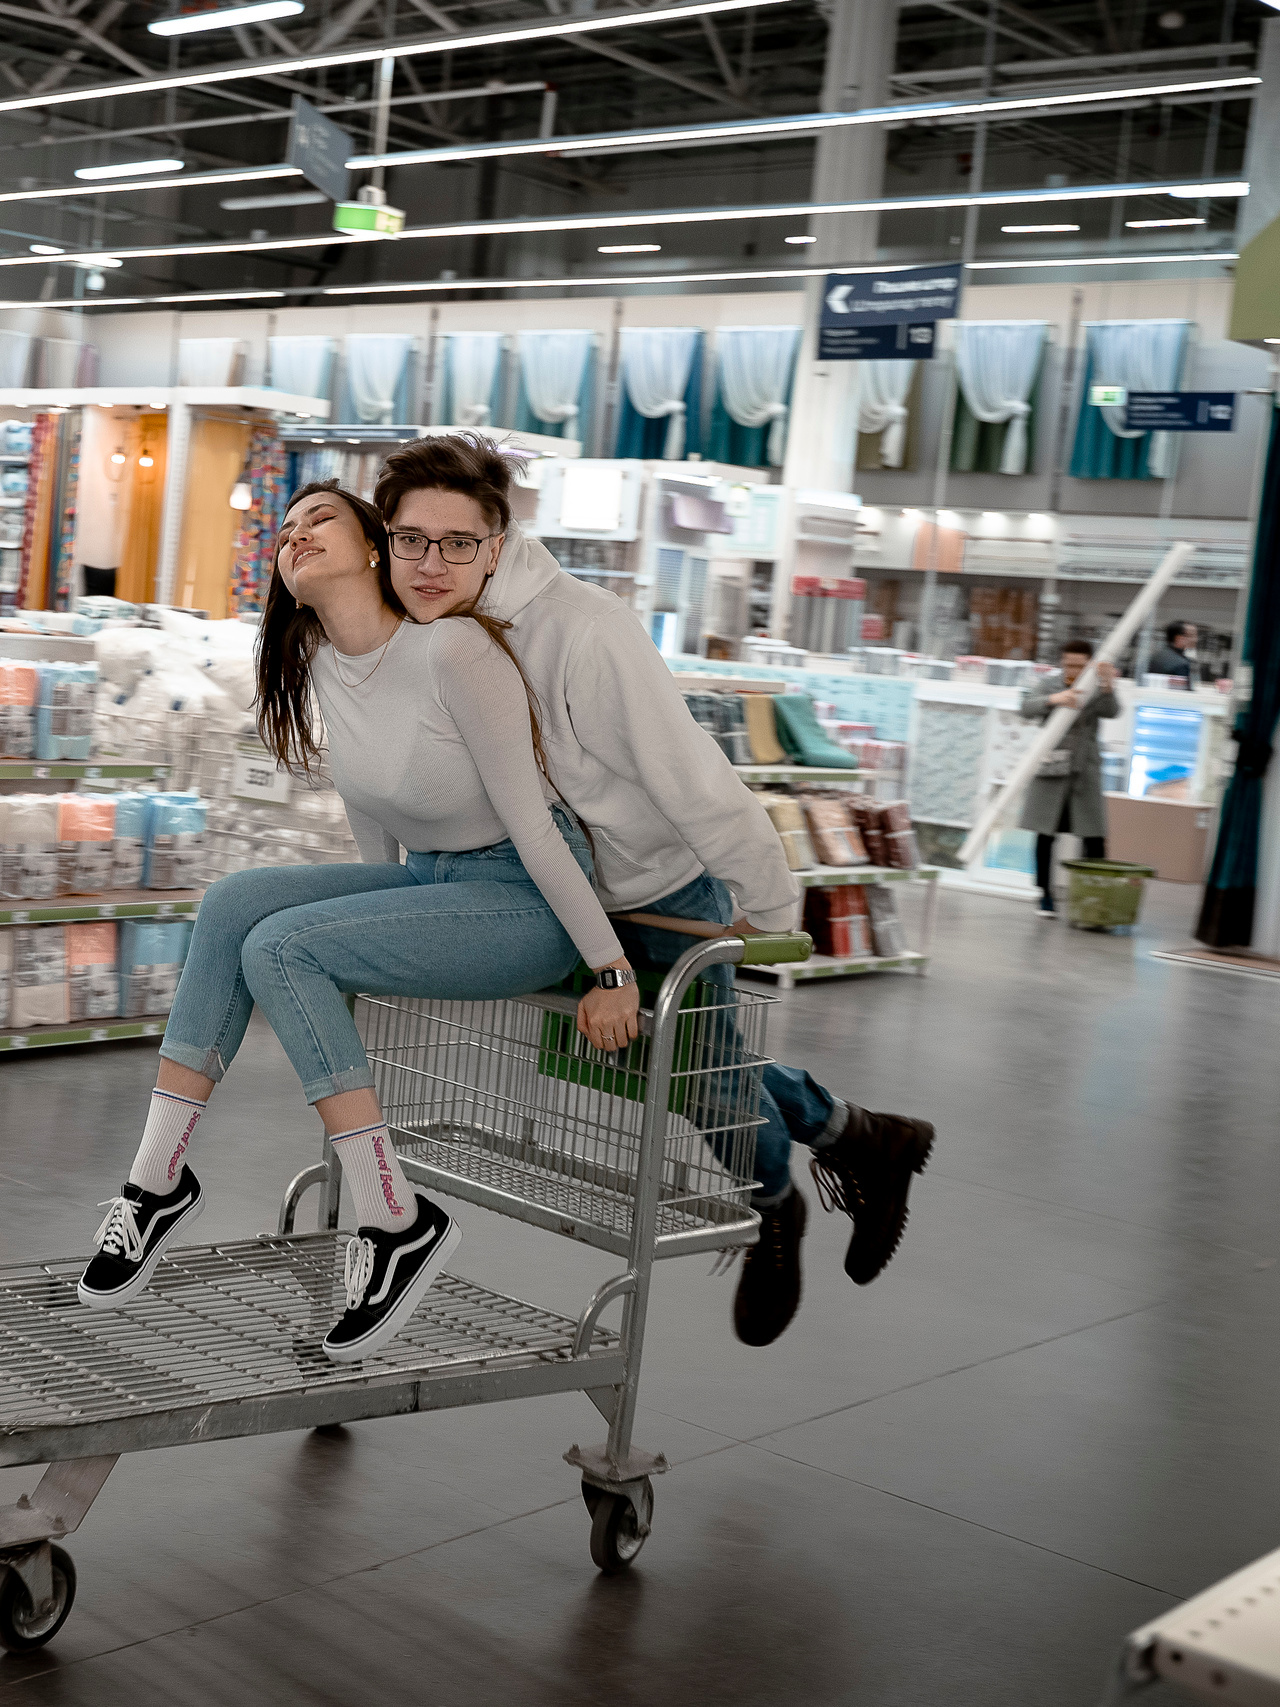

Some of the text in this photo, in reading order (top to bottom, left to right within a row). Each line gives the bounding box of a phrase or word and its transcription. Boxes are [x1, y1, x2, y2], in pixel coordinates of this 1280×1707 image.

[186, 1111, 201, 1134] Sun
[168, 1143, 186, 1181] Beach
[372, 1136, 406, 1216] Sun of Beach
